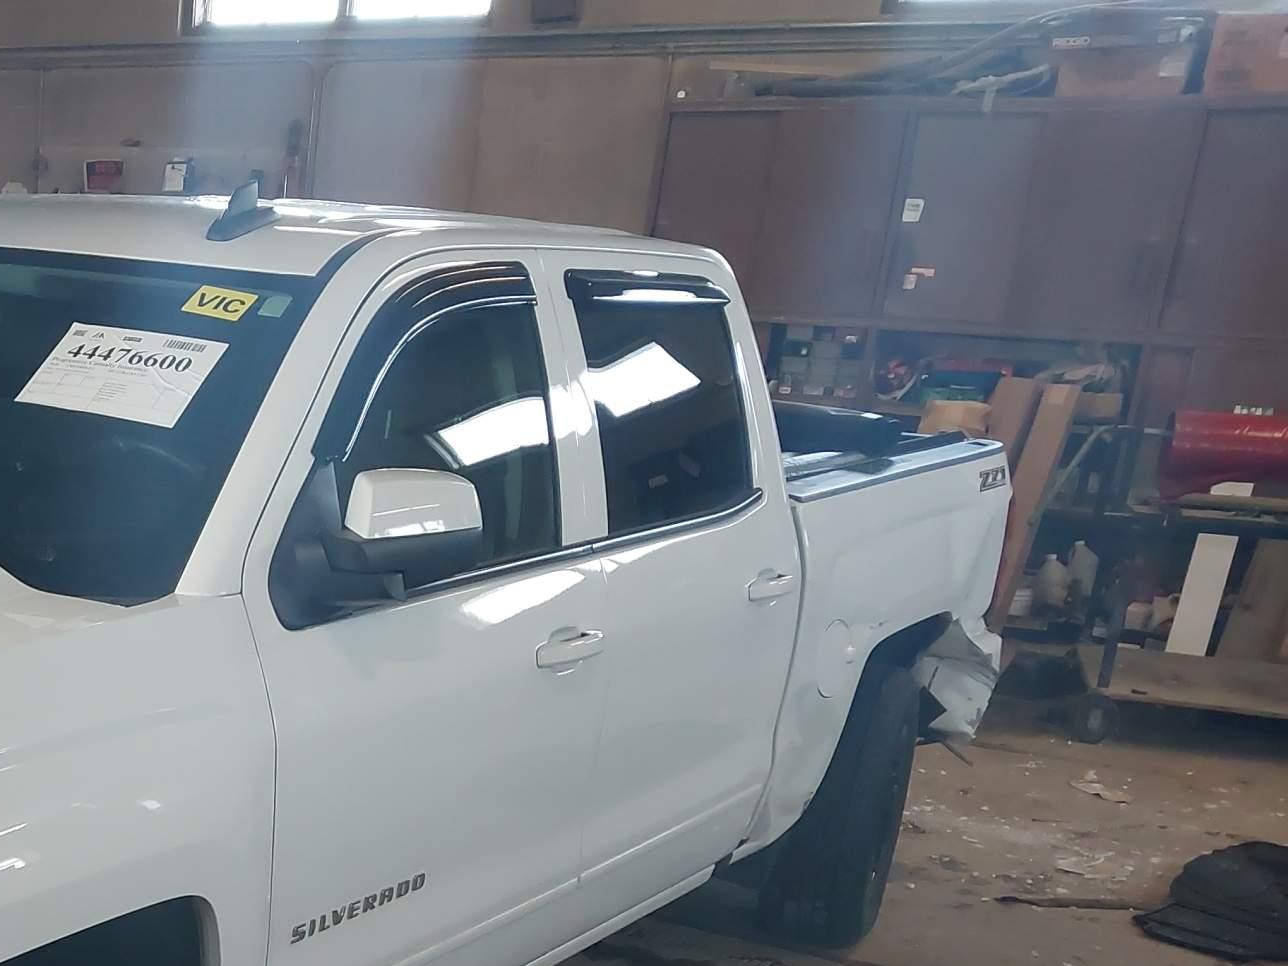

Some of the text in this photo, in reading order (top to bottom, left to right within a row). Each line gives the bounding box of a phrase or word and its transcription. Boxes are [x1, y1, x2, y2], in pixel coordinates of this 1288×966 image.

[196, 291, 247, 315] VIC
[67, 342, 193, 373] 44476600
[290, 872, 426, 944] SILVERADO
